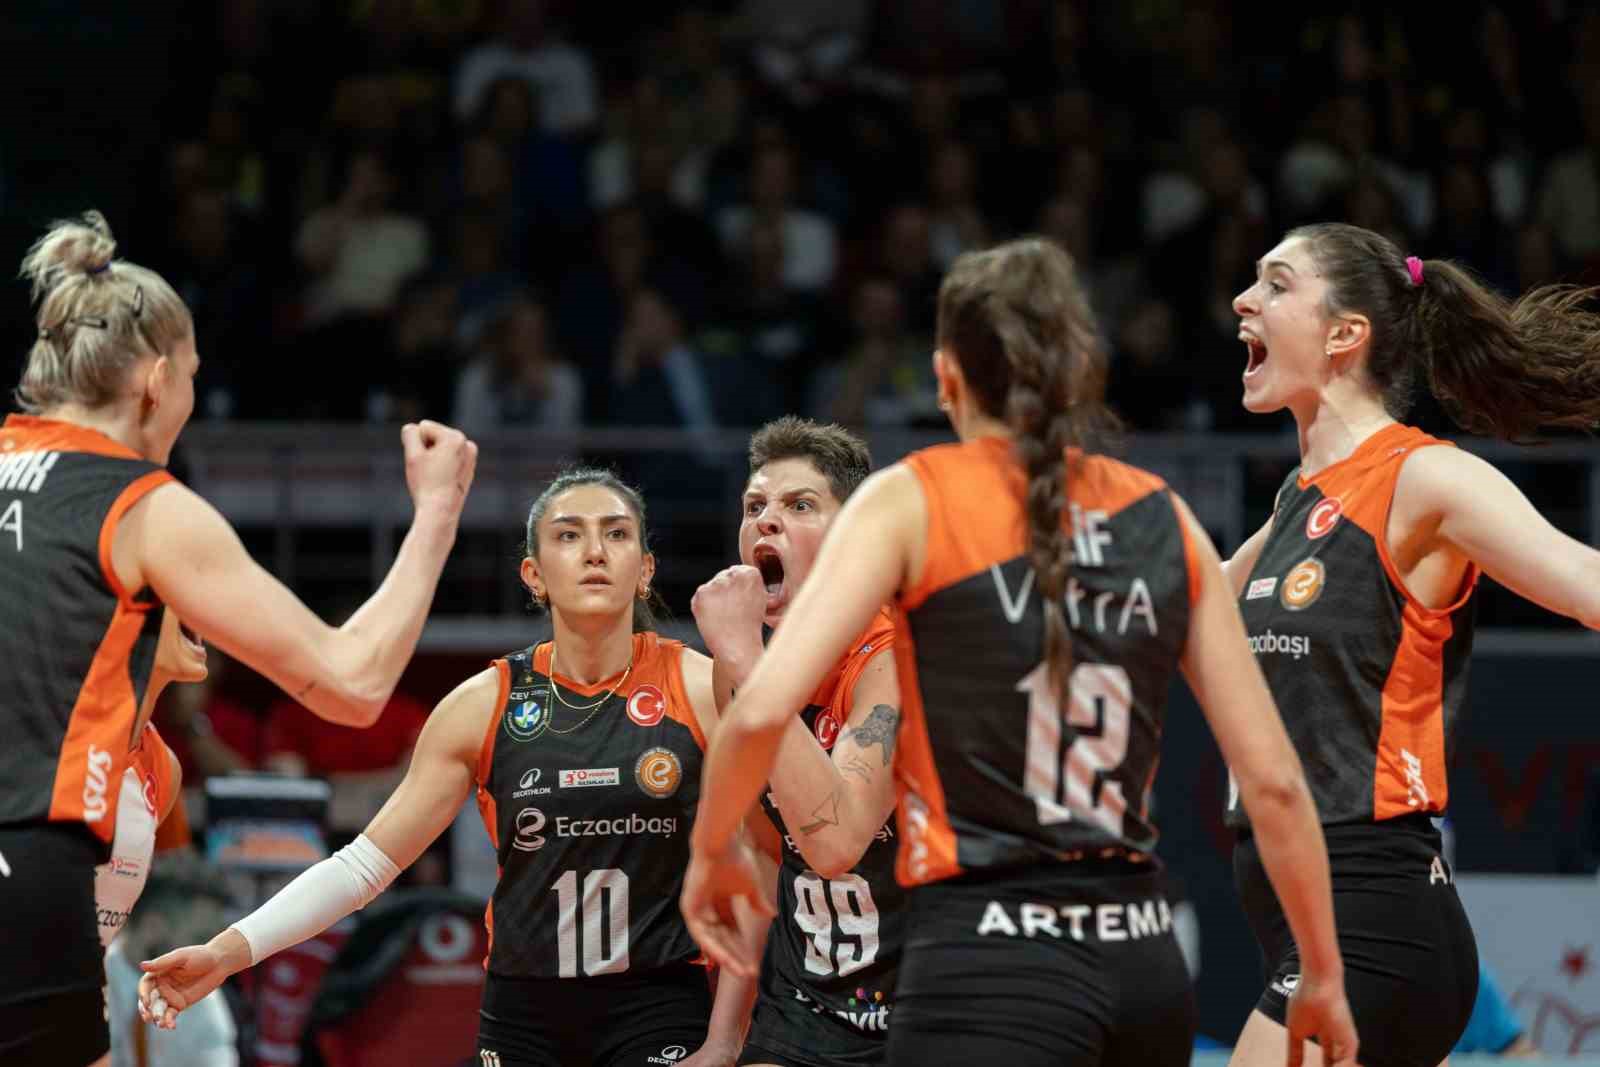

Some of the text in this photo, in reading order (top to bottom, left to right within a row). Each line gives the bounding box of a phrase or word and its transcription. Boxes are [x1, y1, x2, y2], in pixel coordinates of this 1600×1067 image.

[990, 563, 1158, 636] VtrA
[1015, 661, 1134, 838] 12
[555, 812, 677, 839] Eczacıbaşı
[551, 868, 629, 978] 10
[794, 873, 880, 977] 99
